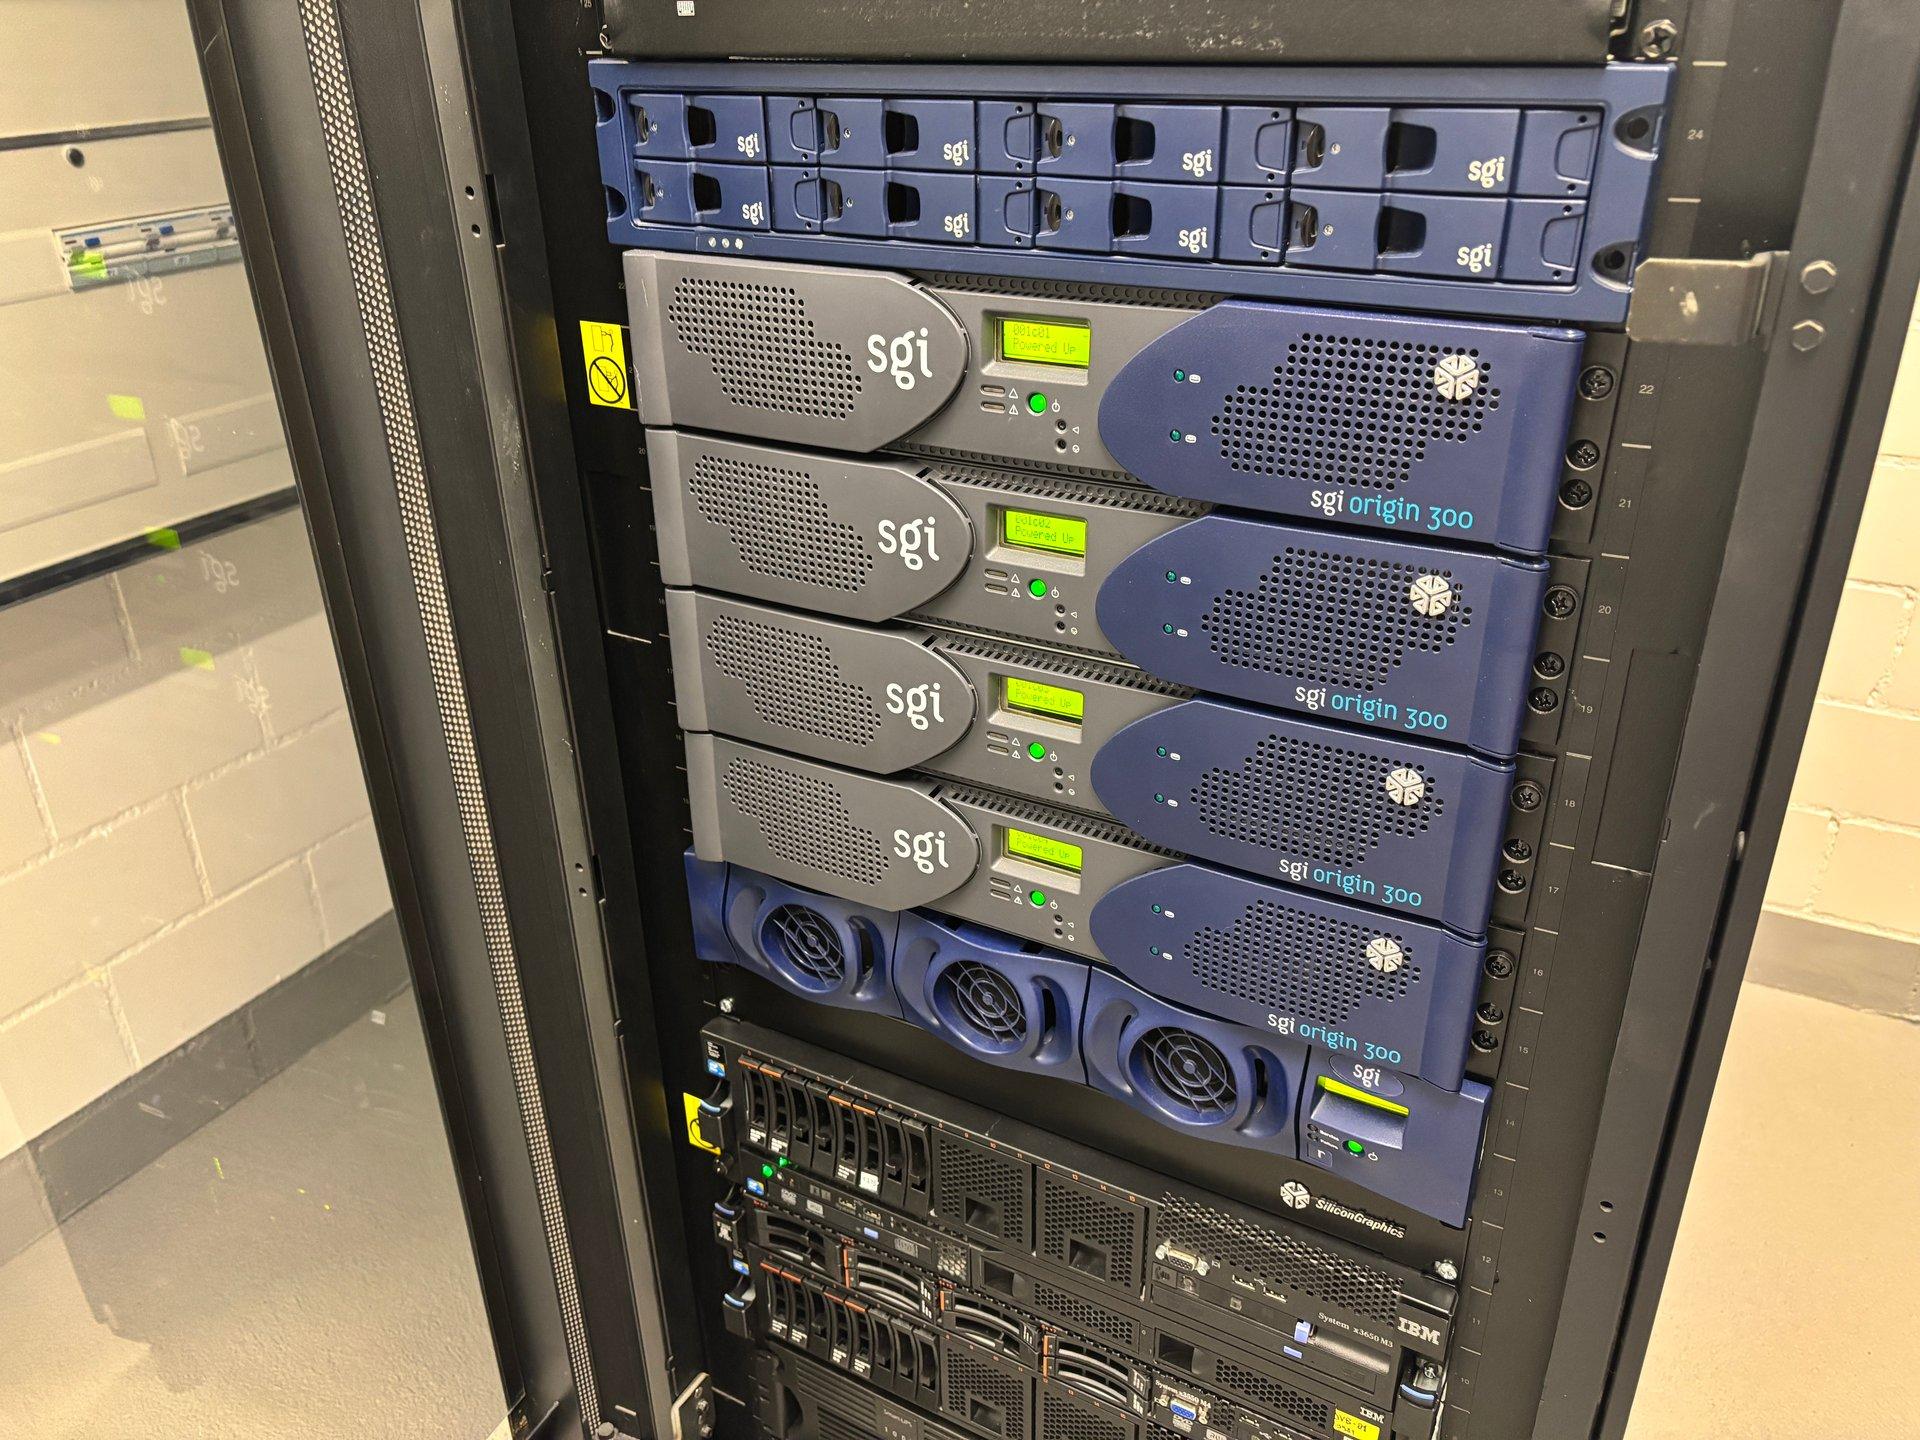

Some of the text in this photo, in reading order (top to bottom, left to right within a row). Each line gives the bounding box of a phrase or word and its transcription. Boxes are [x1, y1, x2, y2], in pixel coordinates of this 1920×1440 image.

[737, 135, 760, 157] sgi
[1687, 129, 1704, 140] 24
[943, 141, 970, 167] sgi
[1182, 149, 1213, 178] sgi
[1468, 156, 1505, 189] sgi
[742, 201, 765, 226] sgi
[944, 212, 970, 239] sgi
[1178, 227, 1208, 254] sgi
[1457, 243, 1492, 273] sgi
[1013, 337, 1076, 355] Powered Up
[867, 328, 933, 391] sgi
[1638, 384, 1655, 395] 22
[1310, 489, 1474, 531] sgi origin 300
[1618, 498, 1631, 508] 21
[878, 516, 940, 570] sgi
[1015, 525, 1075, 545] Powered Up
[1598, 605, 1611, 614] 20
[886, 682, 945, 730] sgi
[1016, 688, 1072, 709] Powered Up
[1295, 686, 1449, 732] sgi origin 300
[1580, 705, 1593, 714] 19
[1564, 799, 1576, 808] 18
[893, 828, 949, 876] sgi
[1279, 857, 1423, 908] sgi origin 300
[1548, 885, 1559, 894] 17
[1533, 968, 1543, 977] 16
[1267, 1012, 1402, 1066] sgi origin 300
[1519, 1045, 1529, 1054] 15
[1353, 1064, 1381, 1088] sgi
[1506, 1118, 1516, 1127] 14
[1493, 1188, 1503, 1197] 13
[1315, 1196, 1405, 1239] SiliconGraphics
[1482, 1255, 1492, 1264] 12
[1318, 1312, 1394, 1348] System x3650 M3
[1398, 1317, 1440, 1346] IBM
[1472, 1317, 1481, 1326] 11
[1460, 1377, 1470, 1386] 10
[1360, 1407, 1385, 1424] IBM
